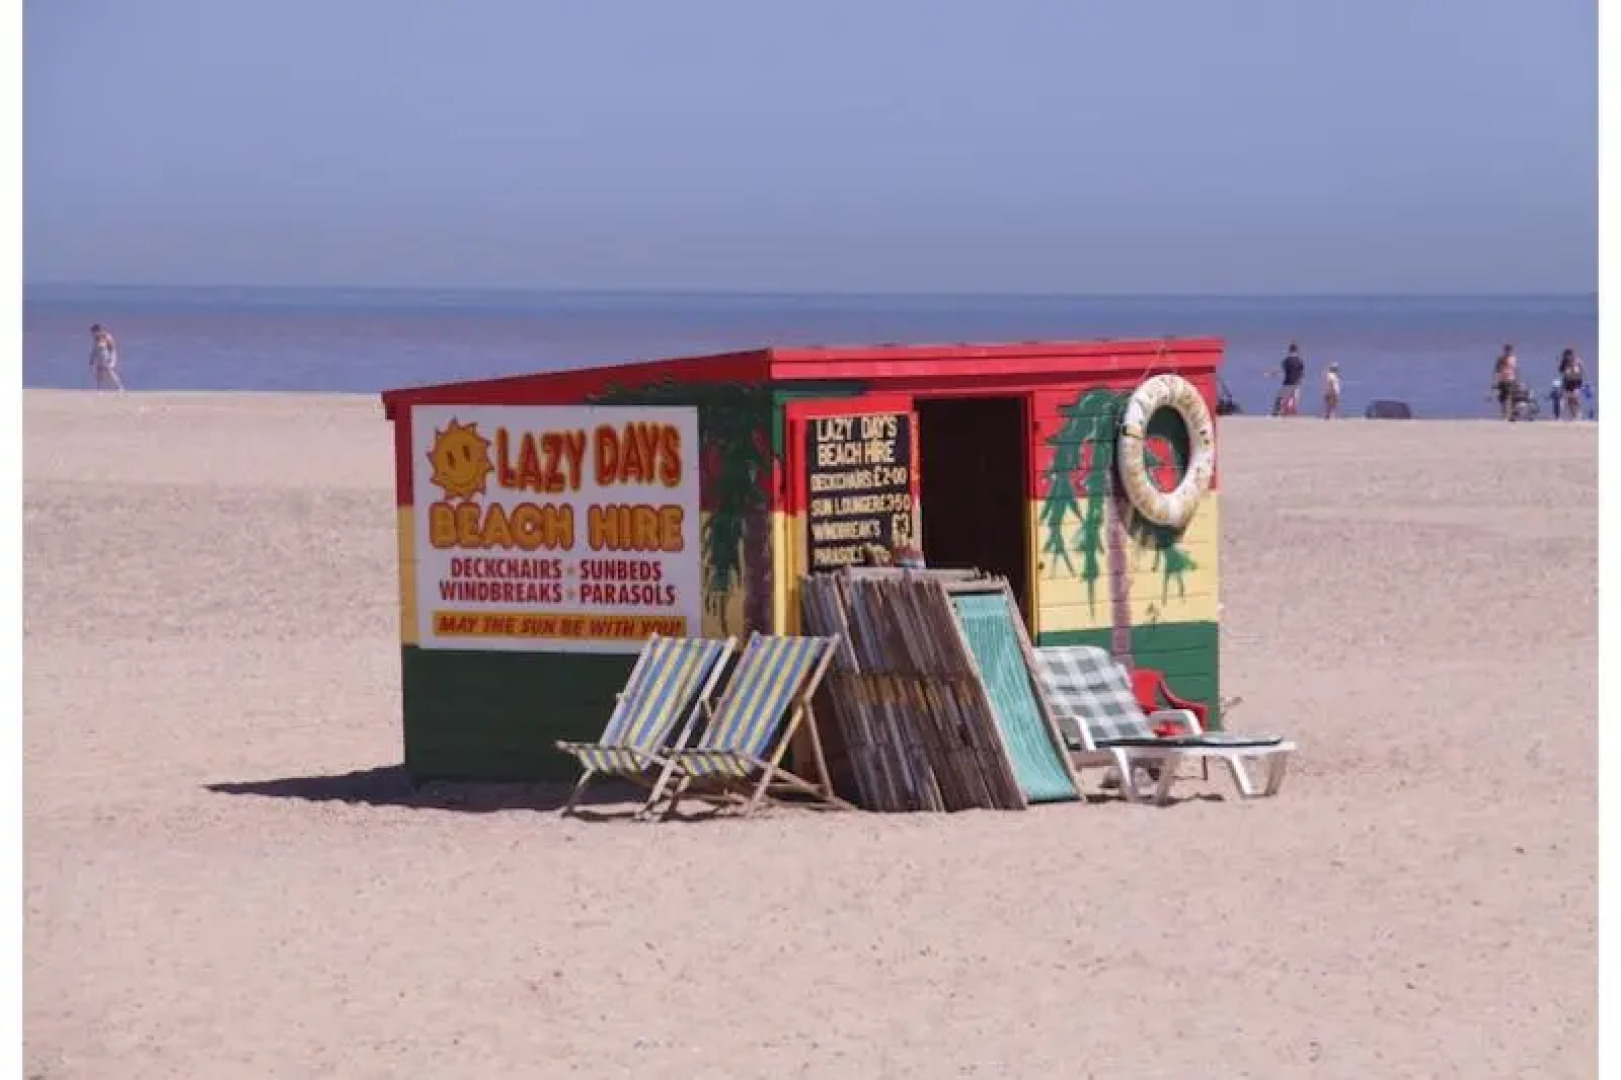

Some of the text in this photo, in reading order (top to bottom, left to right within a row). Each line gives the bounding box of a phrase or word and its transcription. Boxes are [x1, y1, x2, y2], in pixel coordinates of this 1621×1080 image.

[496, 420, 682, 494] LAZY DAYS
[818, 441, 861, 467] BEACH
[429, 502, 684, 553] BEACH HIRE
[450, 558, 662, 582] DECKCHAIRS SUNBEDS
[439, 580, 676, 607] WINDBREAKS PARASOLS
[438, 616, 478, 633] MAY
[482, 616, 516, 635] THE
[521, 617, 557, 635] SUN
[560, 619, 586, 636] BE
[589, 619, 636, 637] WITH
